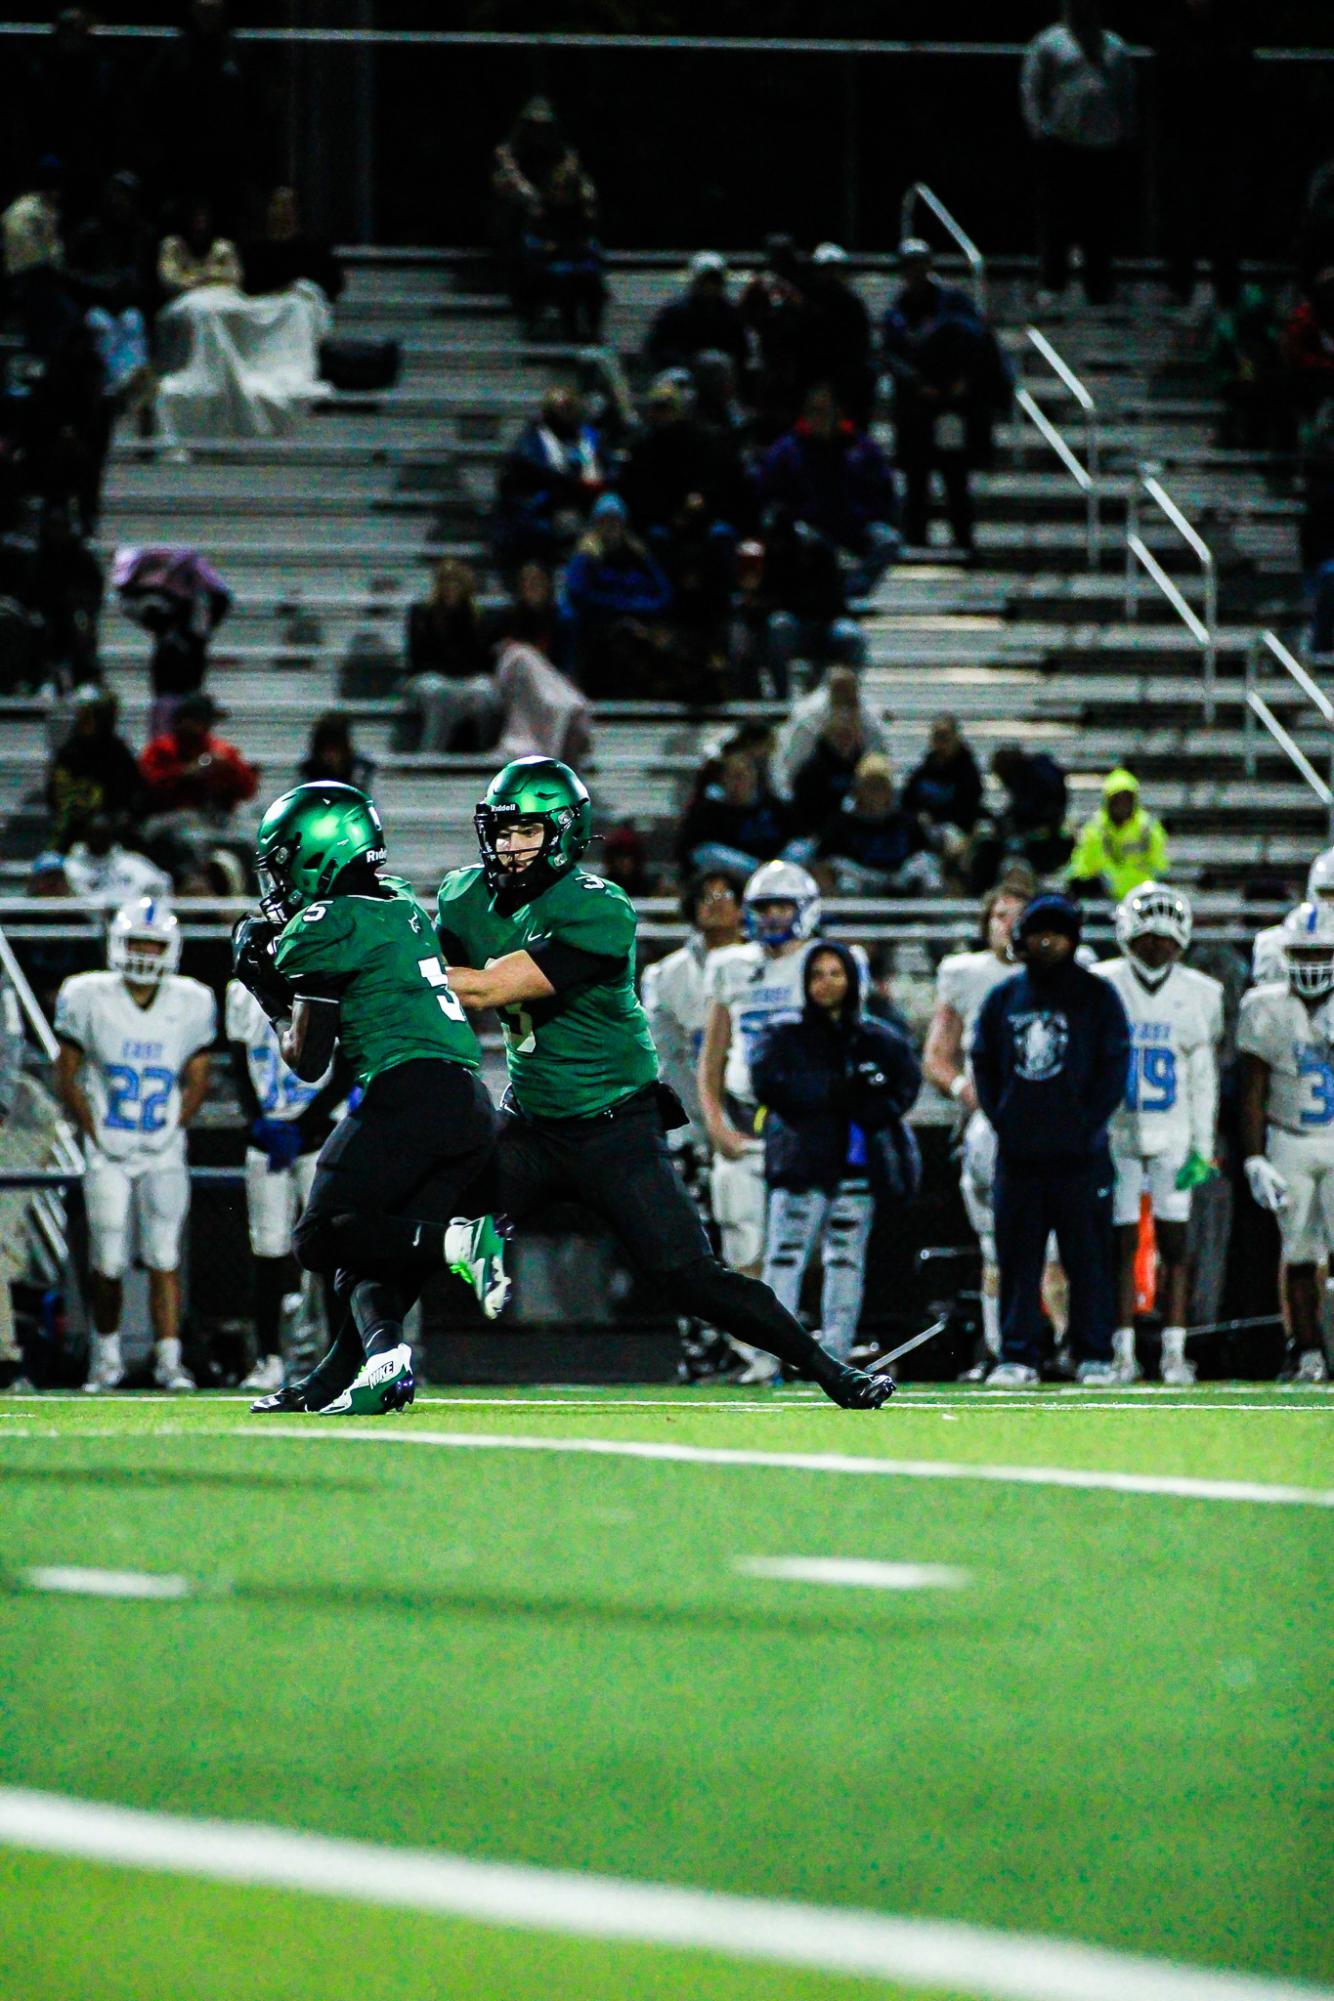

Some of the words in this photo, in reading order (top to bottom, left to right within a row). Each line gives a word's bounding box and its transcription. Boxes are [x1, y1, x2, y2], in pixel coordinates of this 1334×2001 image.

[574, 873, 606, 889] 3
[302, 900, 334, 922] 5
[1126, 1048, 1175, 1112] 19
[103, 1064, 174, 1133] 22
[368, 1360, 394, 1390] NIKE
